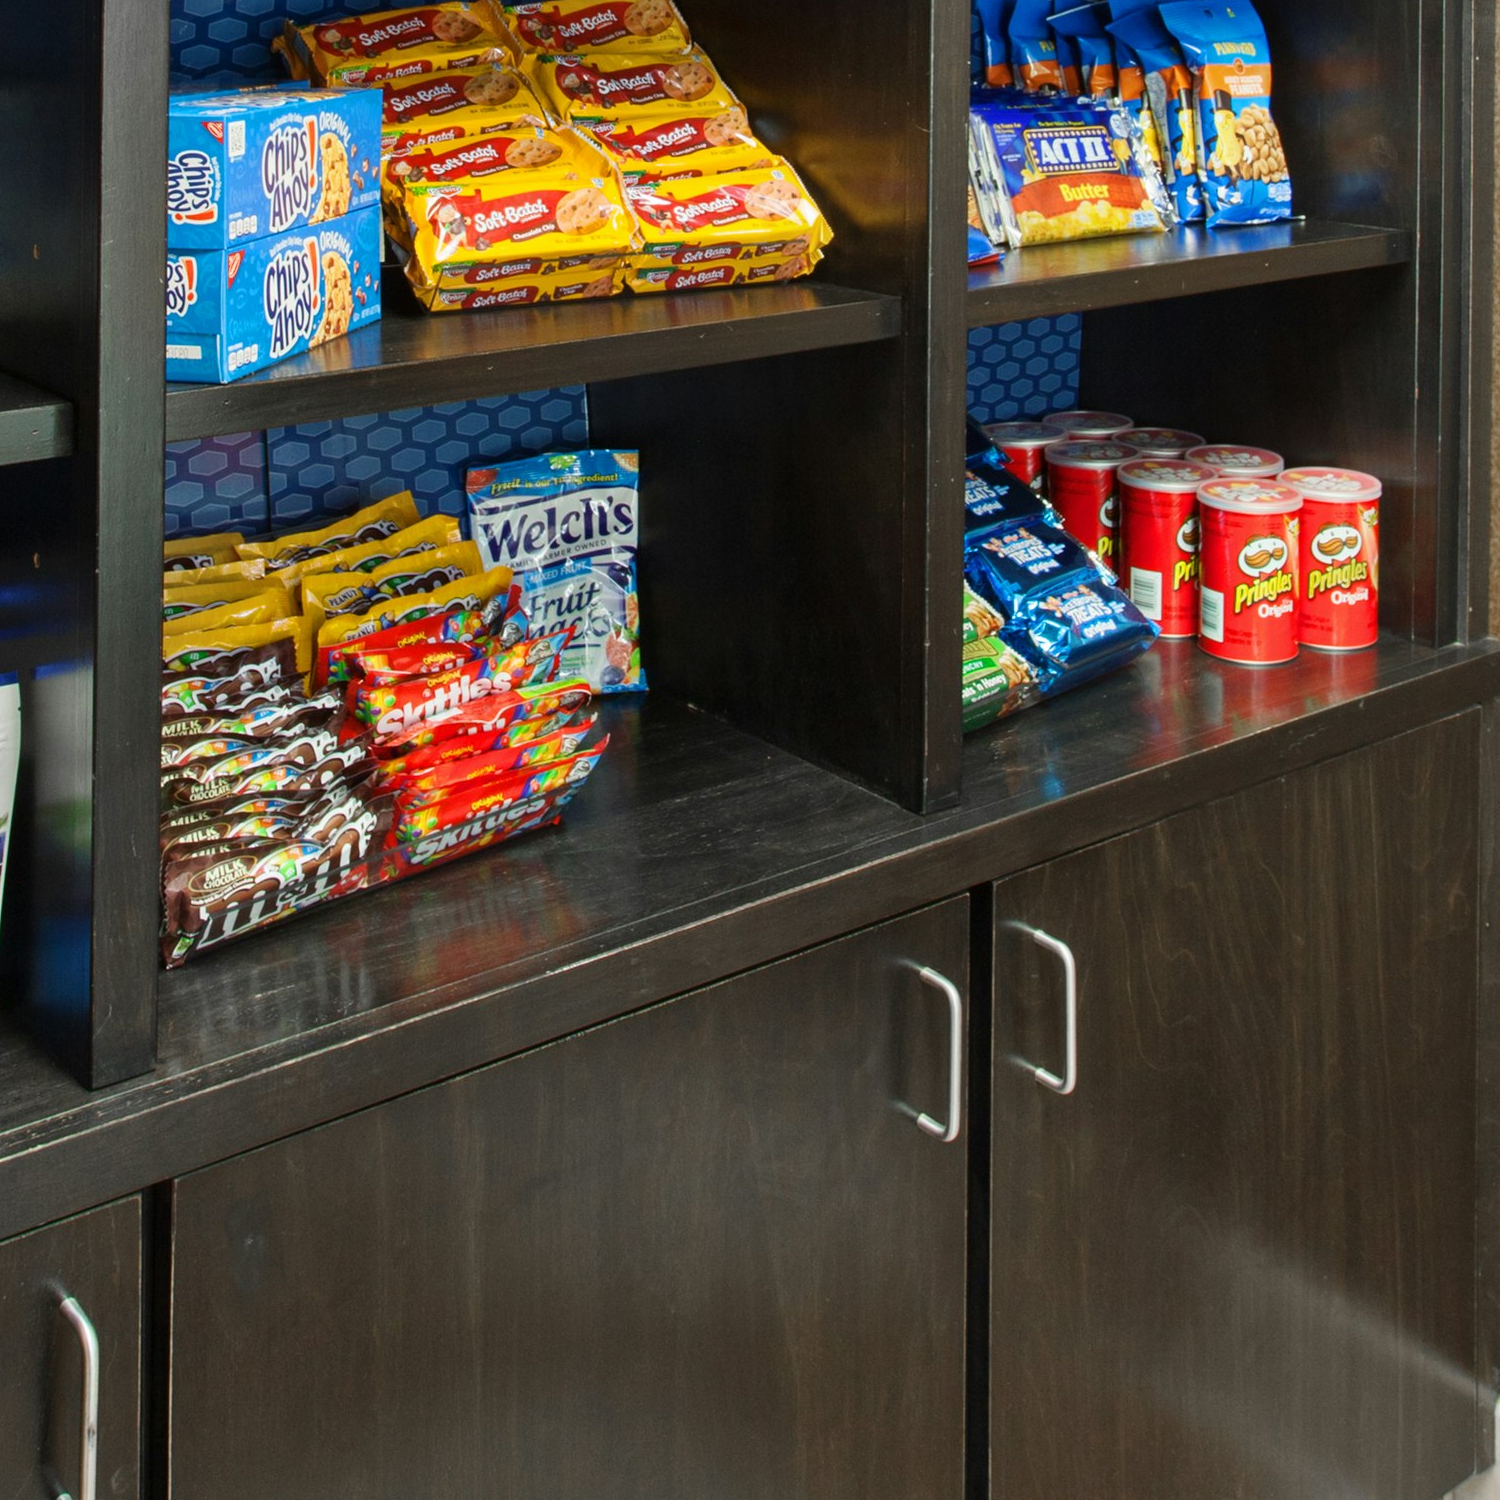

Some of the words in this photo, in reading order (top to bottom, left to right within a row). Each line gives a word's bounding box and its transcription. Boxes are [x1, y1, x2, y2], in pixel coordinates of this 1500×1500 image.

[559, 22, 584, 38] Soft
[583, 8, 618, 30] Batch
[318, 110, 352, 148] ORIGINAL
[633, 138, 661, 156] Soft
[660, 122, 698, 146] Batch
[264, 124, 308, 194] Chips
[431, 157, 462, 175] Soft
[461, 144, 499, 163] Batch
[1040, 138, 1082, 165] ACT
[1079, 136, 1110, 162] II
[1059, 183, 1110, 203] Butter
[474, 212, 506, 234] Soft
[505, 199, 550, 224] Batch
[512, 228, 541, 241] Chocolate
[540, 223, 556, 234] Chip
[319, 230, 353, 262] ORIGINAL
[266, 248, 310, 318] Chips
[480, 495, 635, 564] Welch's
[574, 537, 607, 553] OWNED
[529, 569, 560, 583] MIXED
[560, 561, 589, 577] FRUIT
[1308, 558, 1368, 599] Pringles
[328, 588, 359, 607] PEANUT
[528, 581, 601, 622] Fruit
[1234, 569, 1293, 614] Pringles
[1068, 599, 1113, 626] TREATS
[1083, 619, 1116, 637] original
[373, 671, 513, 746] Skittles
[203, 867, 248, 890] CHOCOLATE
[205, 856, 246, 881] MILK
